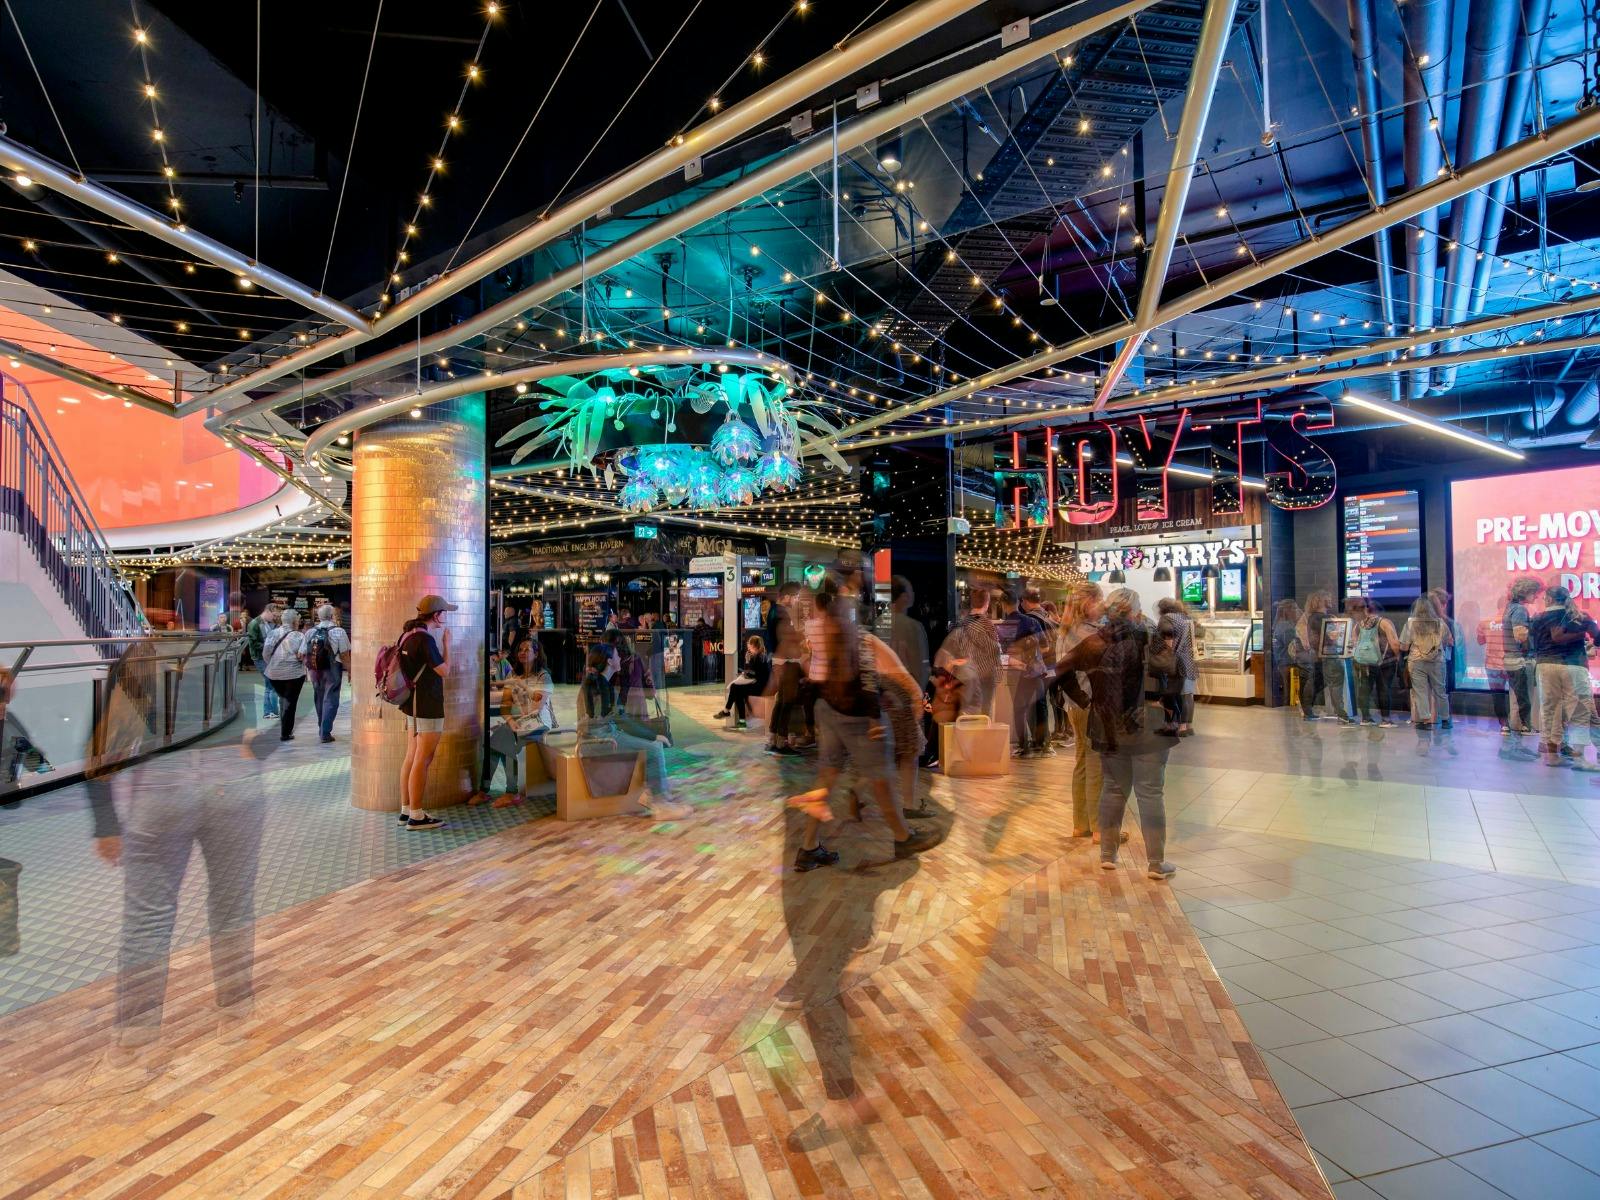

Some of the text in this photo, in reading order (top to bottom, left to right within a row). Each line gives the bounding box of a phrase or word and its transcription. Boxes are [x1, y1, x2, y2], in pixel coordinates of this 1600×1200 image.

[994, 390, 1337, 530] HOYTS
[1162, 520, 1174, 528] ICE
[1176, 518, 1203, 527] CREAM
[532, 540, 624, 555] TRADITIONAL ENGLISH TAVERN
[1078, 550, 1125, 573] BEN
[1143, 538, 1247, 569] JERRY'S
[1506, 541, 1582, 571] NOW
[726, 567, 736, 581] 3
